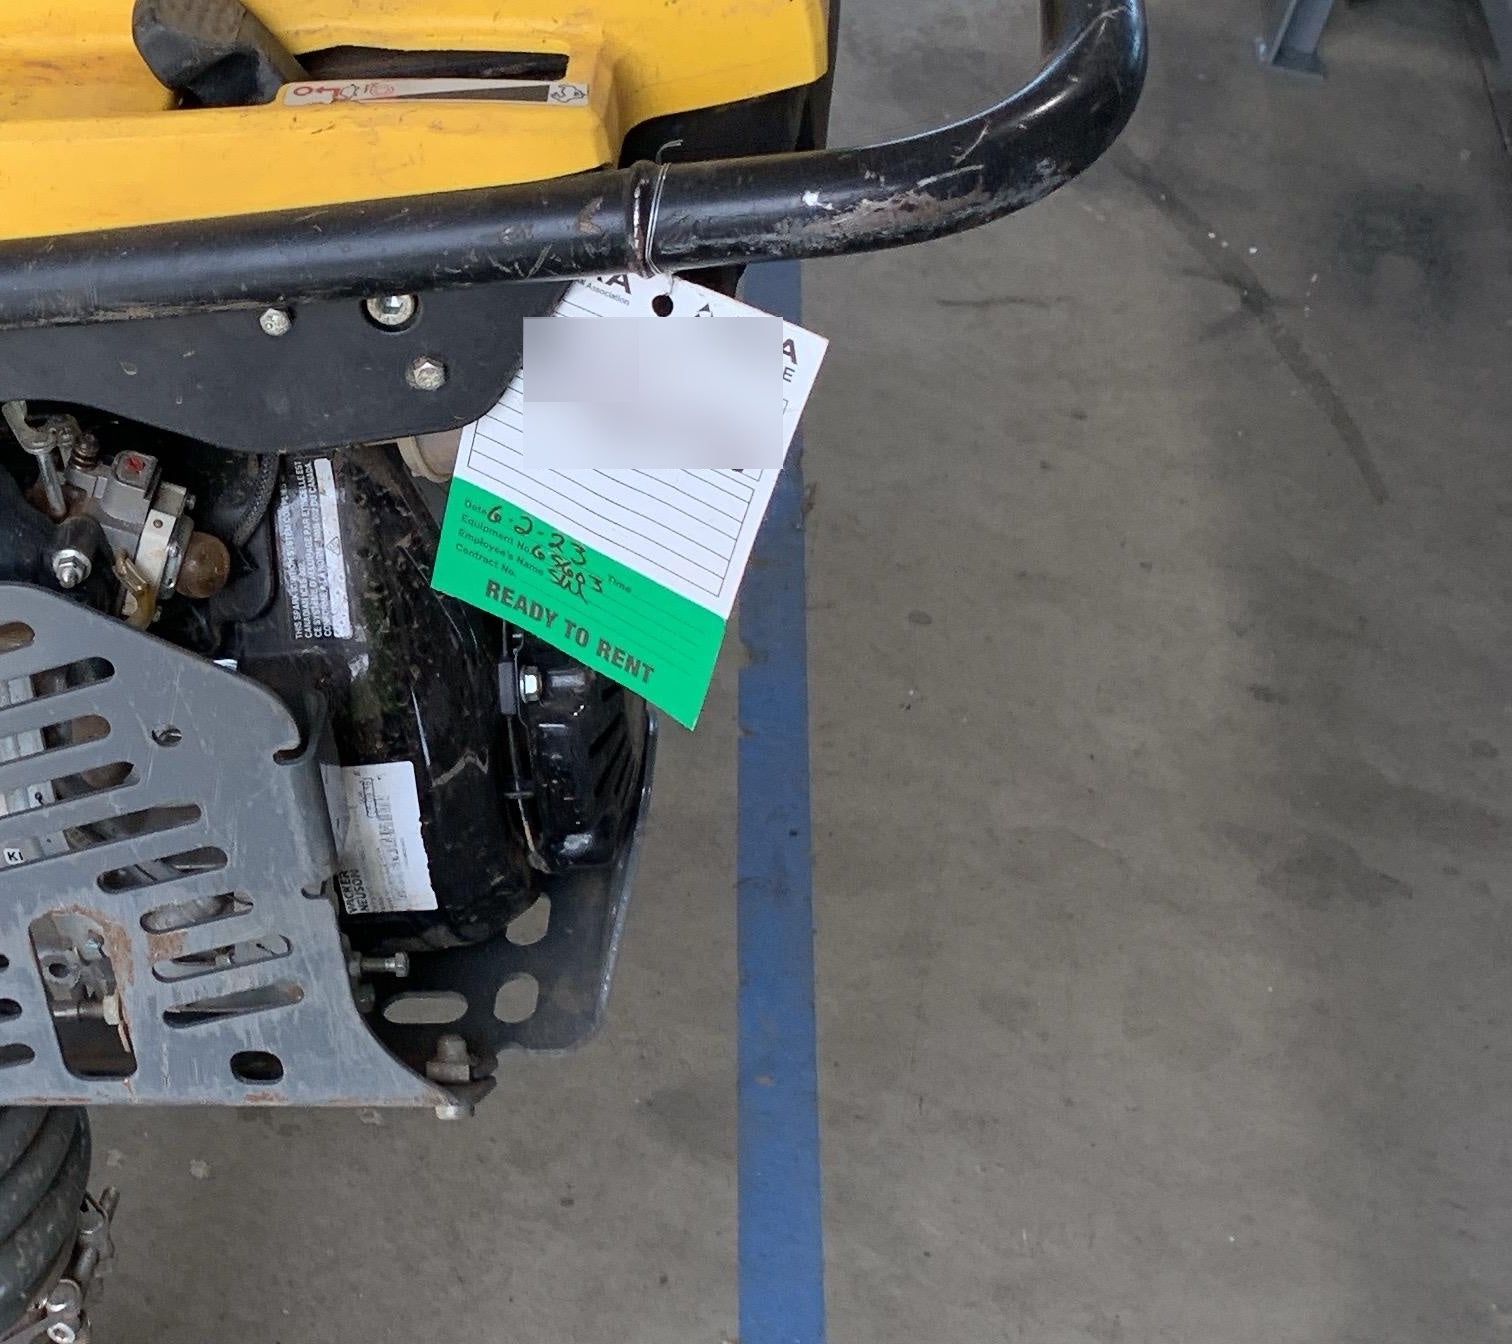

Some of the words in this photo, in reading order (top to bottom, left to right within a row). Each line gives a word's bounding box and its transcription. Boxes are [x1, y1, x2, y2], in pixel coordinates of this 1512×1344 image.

[586, 281, 630, 306] Association
[294, 461, 304, 474] EST
[309, 494, 318, 506] DU
[462, 514, 514, 545] Equipment
[456, 543, 498, 568] Contract
[516, 556, 544, 576] Name
[294, 621, 303, 639] THIS
[300, 597, 312, 638] CANADIAN
[313, 626, 322, 638] CE
[485, 579, 558, 629] READY
[564, 618, 590, 648] TO
[595, 637, 656, 685] RENT
[351, 869, 368, 912] NEUSON
